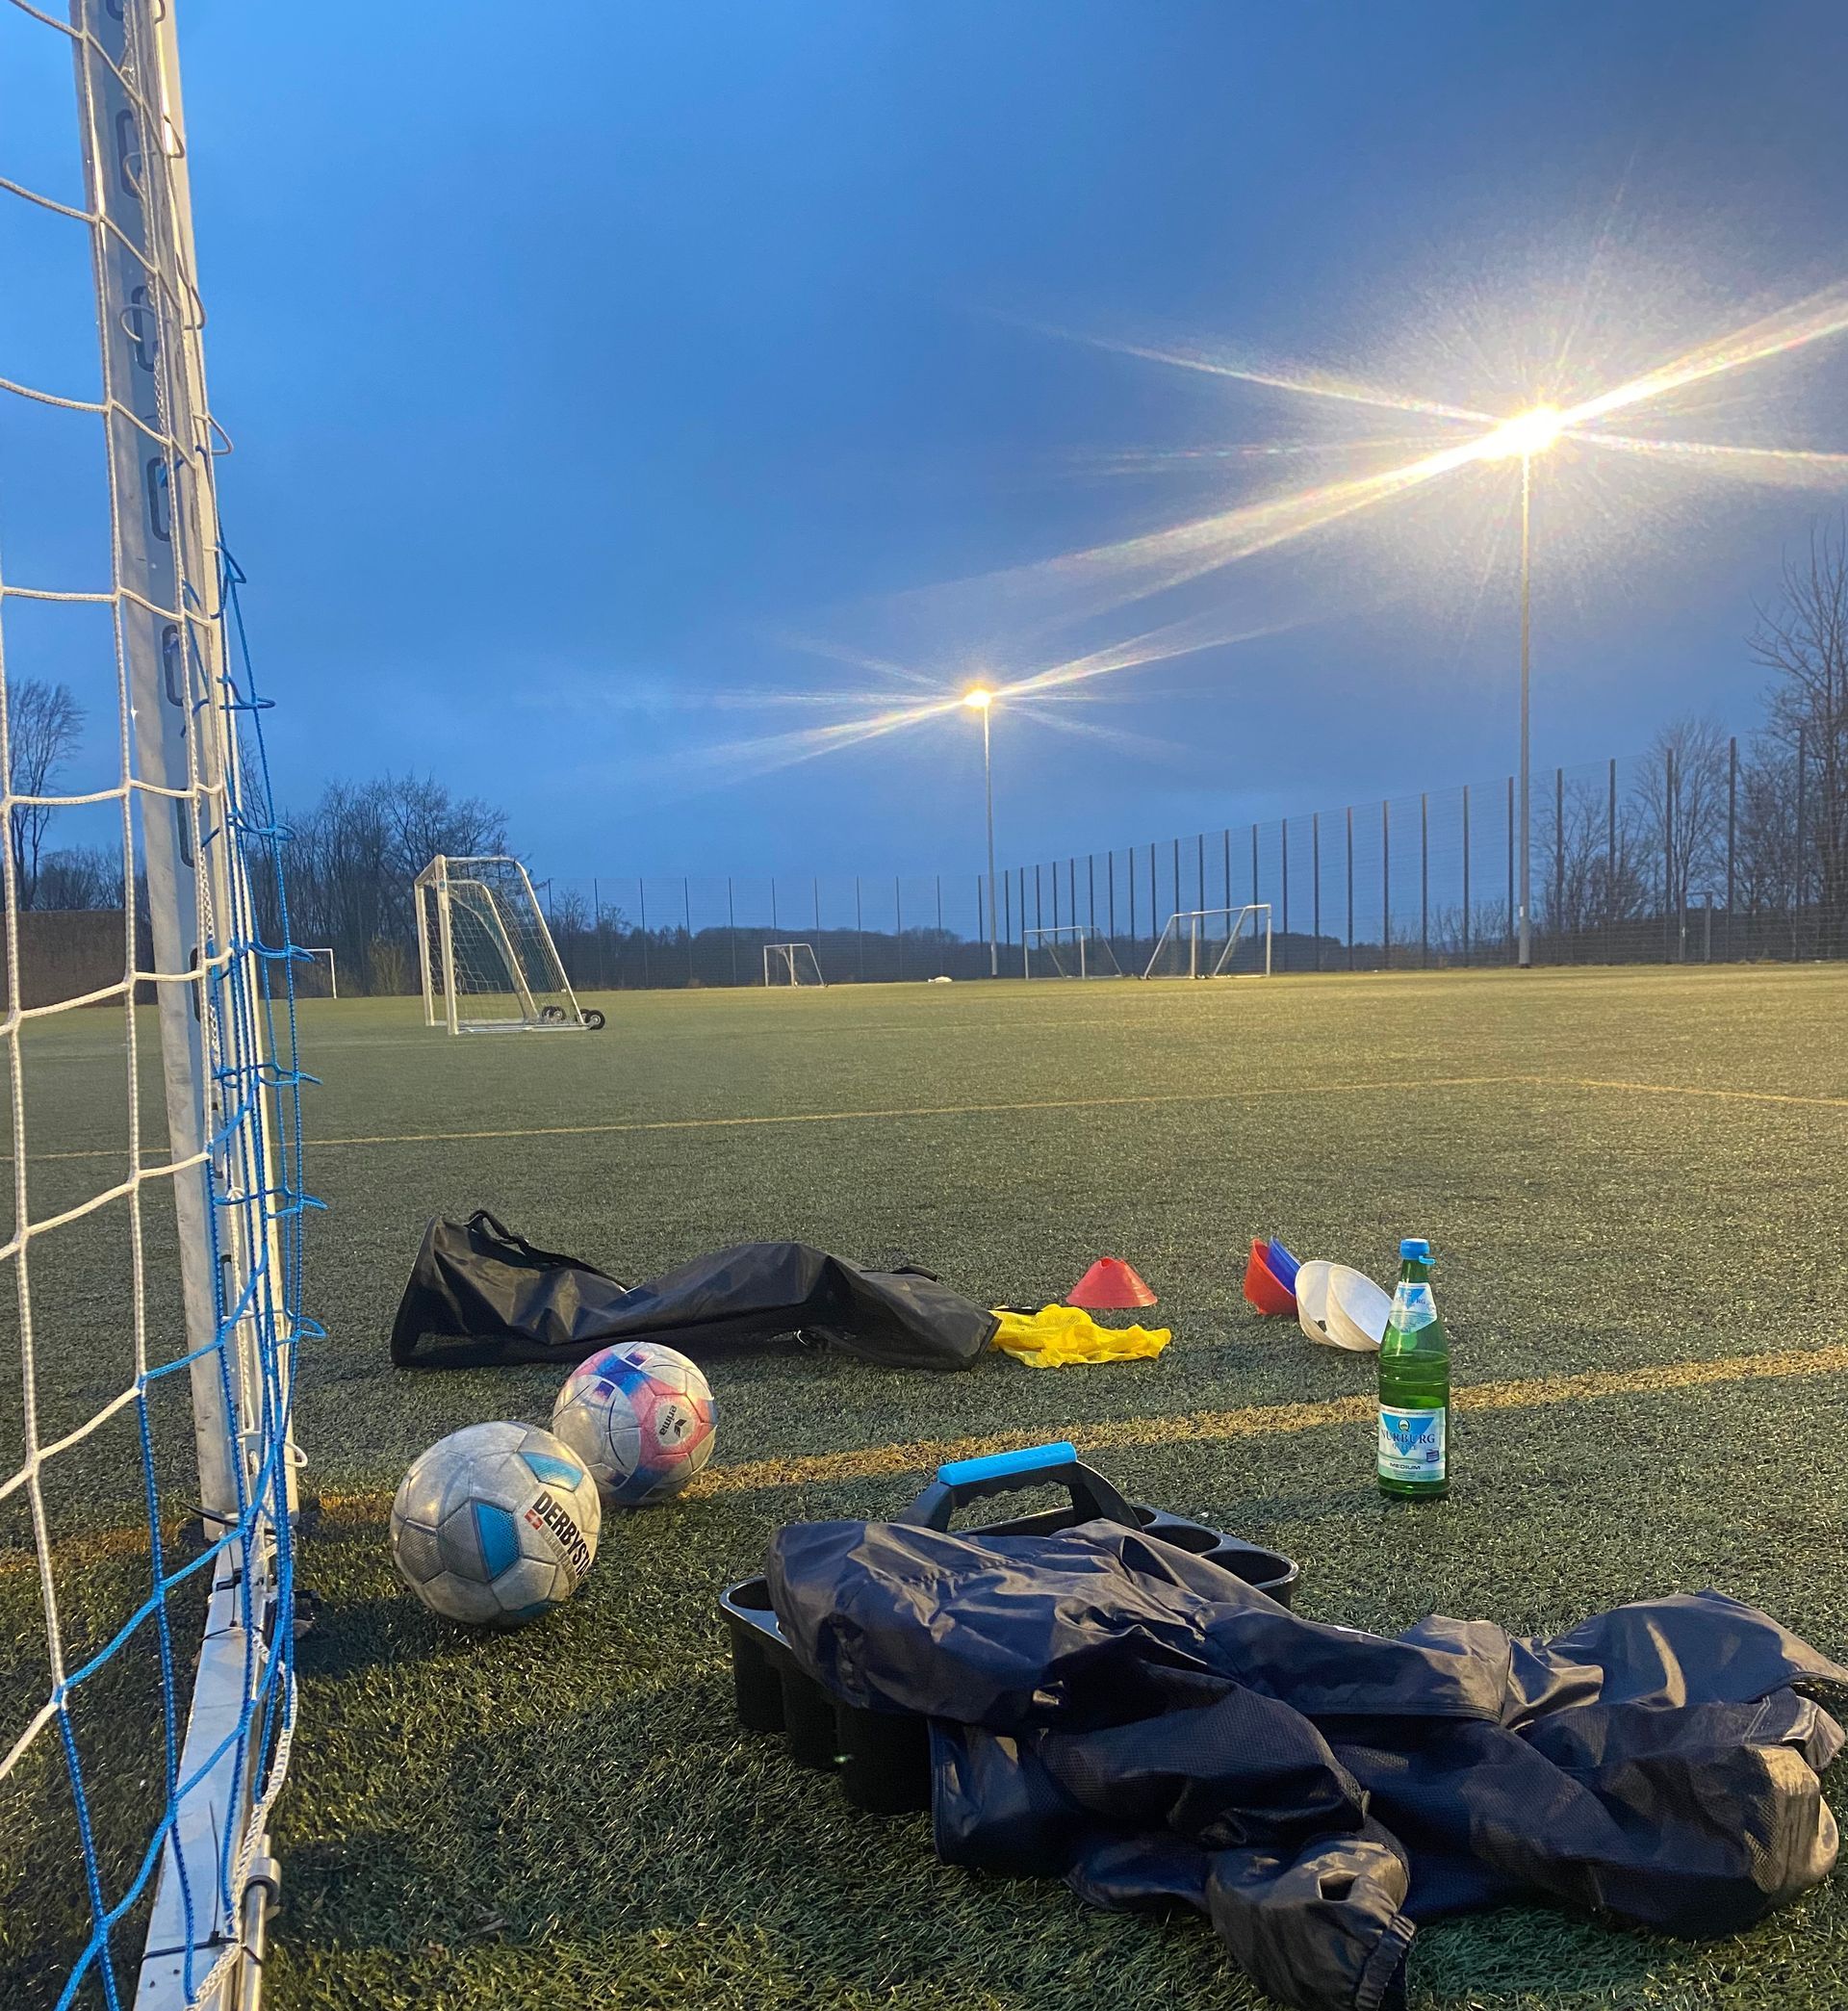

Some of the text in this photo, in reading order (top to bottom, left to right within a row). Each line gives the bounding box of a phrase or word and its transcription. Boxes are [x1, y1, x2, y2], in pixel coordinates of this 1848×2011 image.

[658, 1405, 678, 1436] erima
[1389, 1461, 1422, 1471] MEDIUM
[531, 1490, 591, 1582] DERBYSTA
